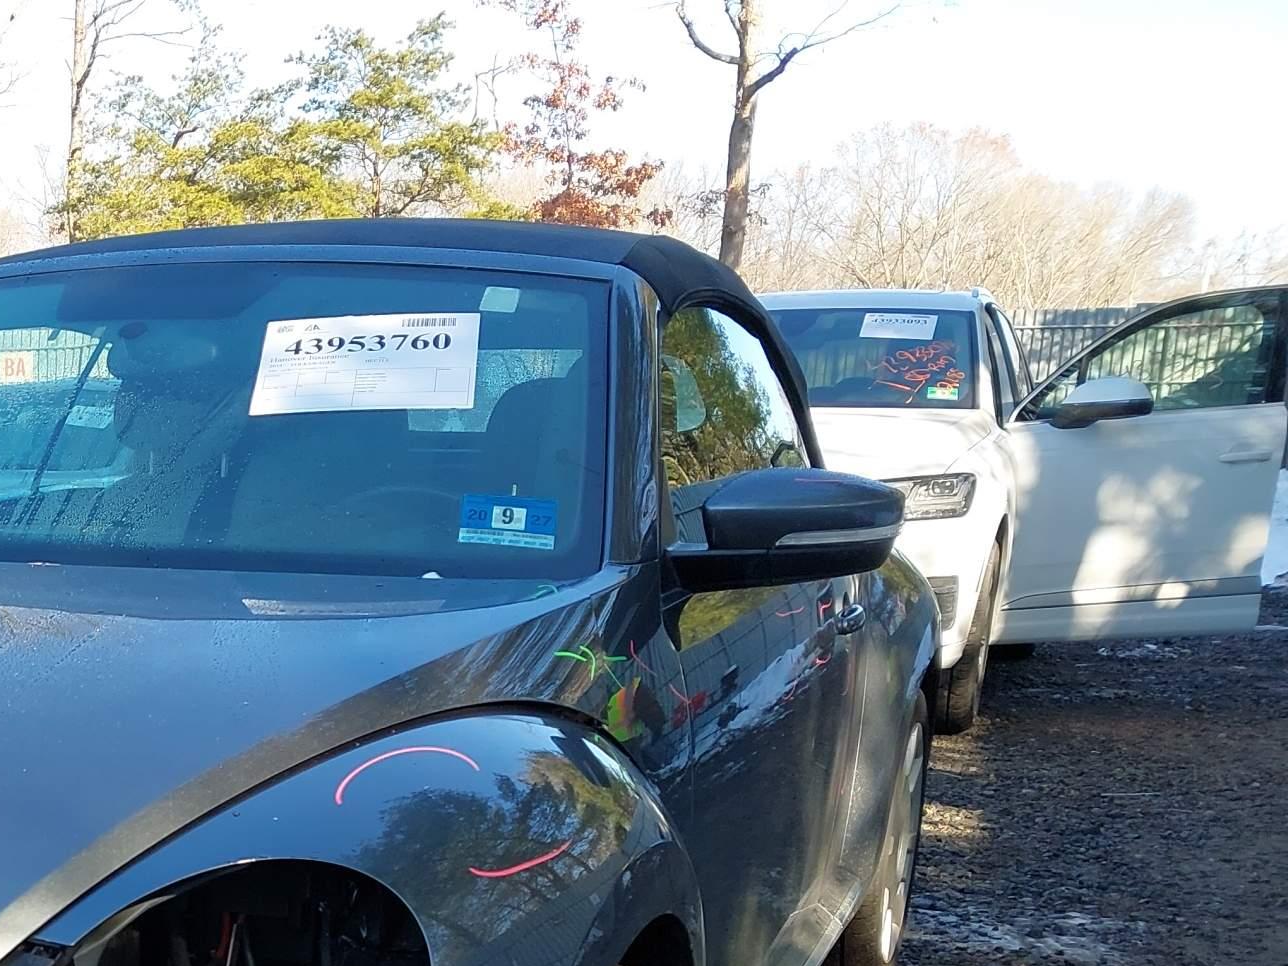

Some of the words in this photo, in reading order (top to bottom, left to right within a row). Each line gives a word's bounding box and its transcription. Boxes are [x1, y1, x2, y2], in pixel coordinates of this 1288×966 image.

[284, 332, 452, 355] 43953760
[4, 357, 26, 377] BA
[468, 508, 488, 521] 20
[502, 507, 515, 525] 9
